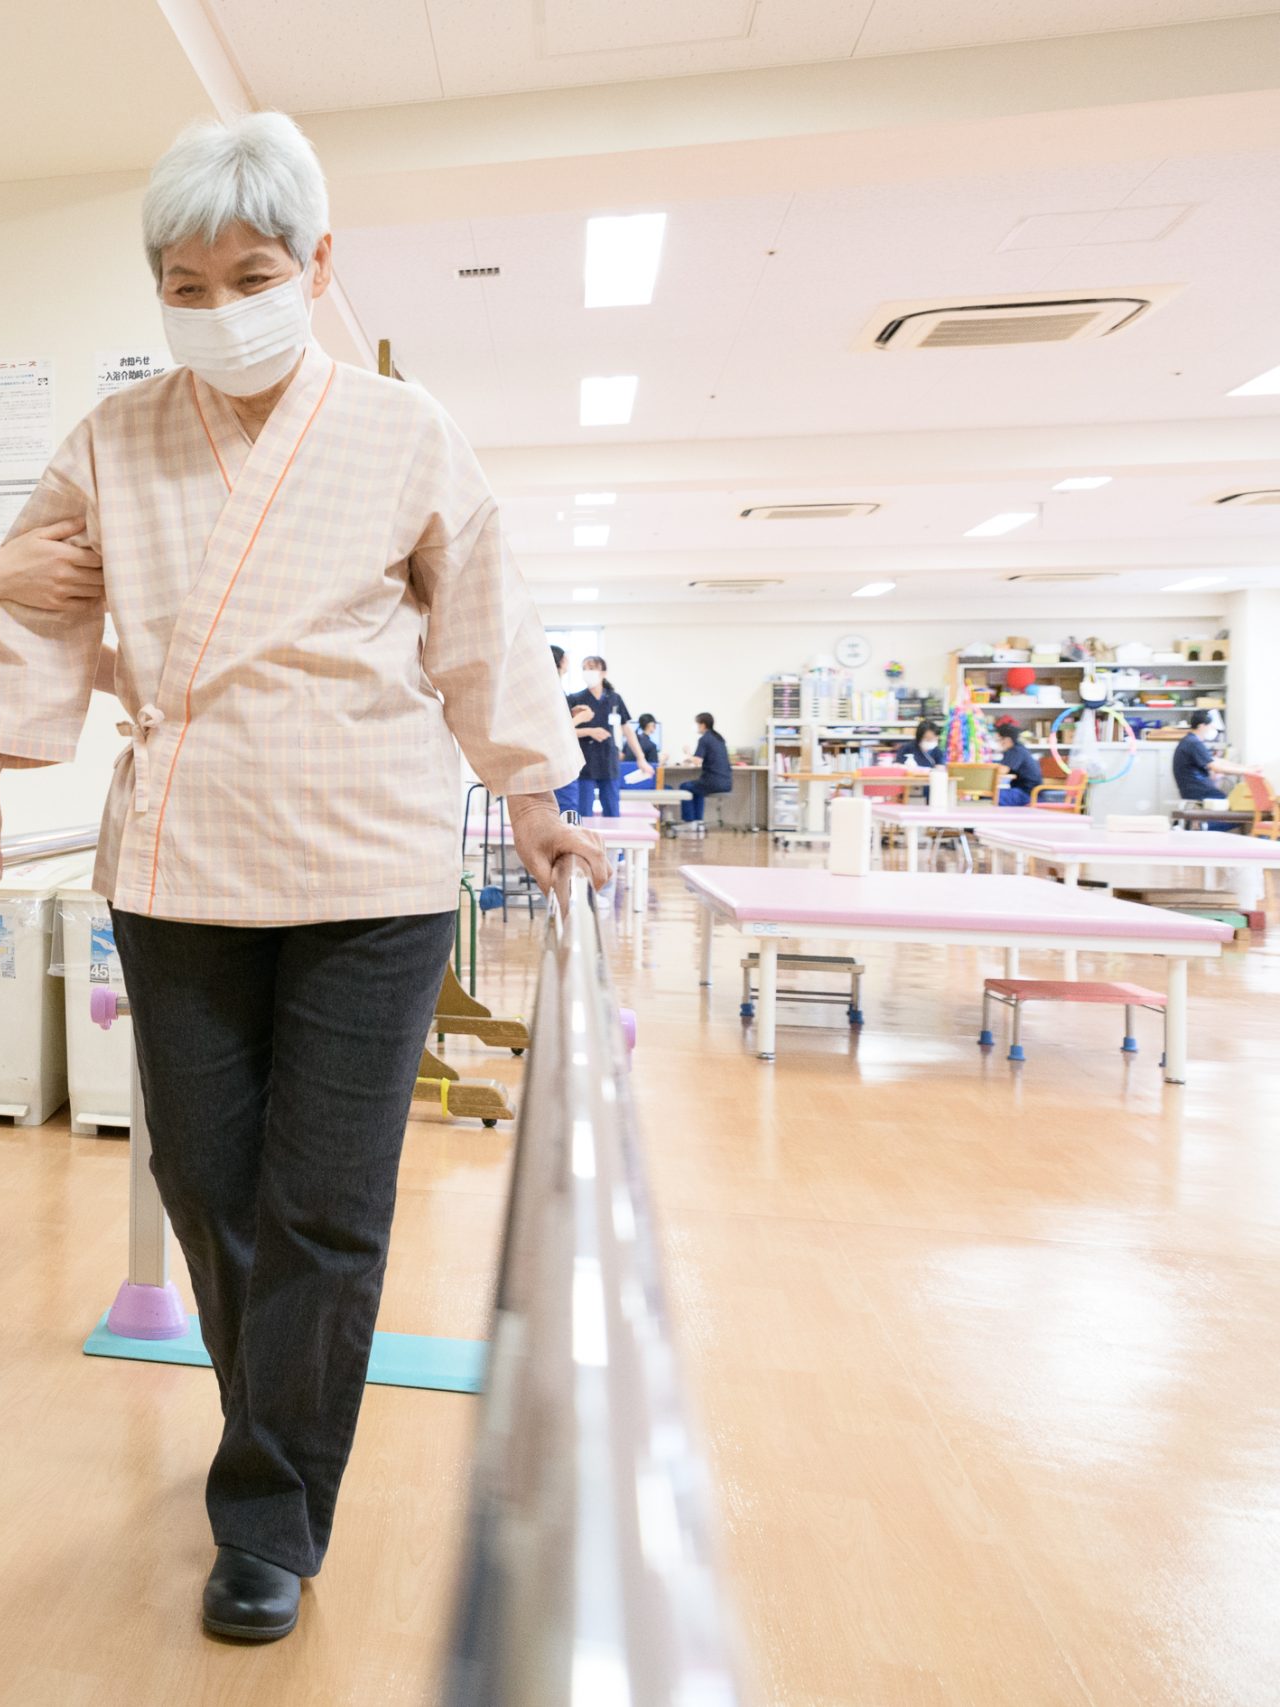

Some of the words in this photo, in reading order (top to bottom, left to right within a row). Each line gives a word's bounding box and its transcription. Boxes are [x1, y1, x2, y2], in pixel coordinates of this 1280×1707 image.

[120, 356, 150, 367] お知らせ
[91, 964, 109, 978] 45
